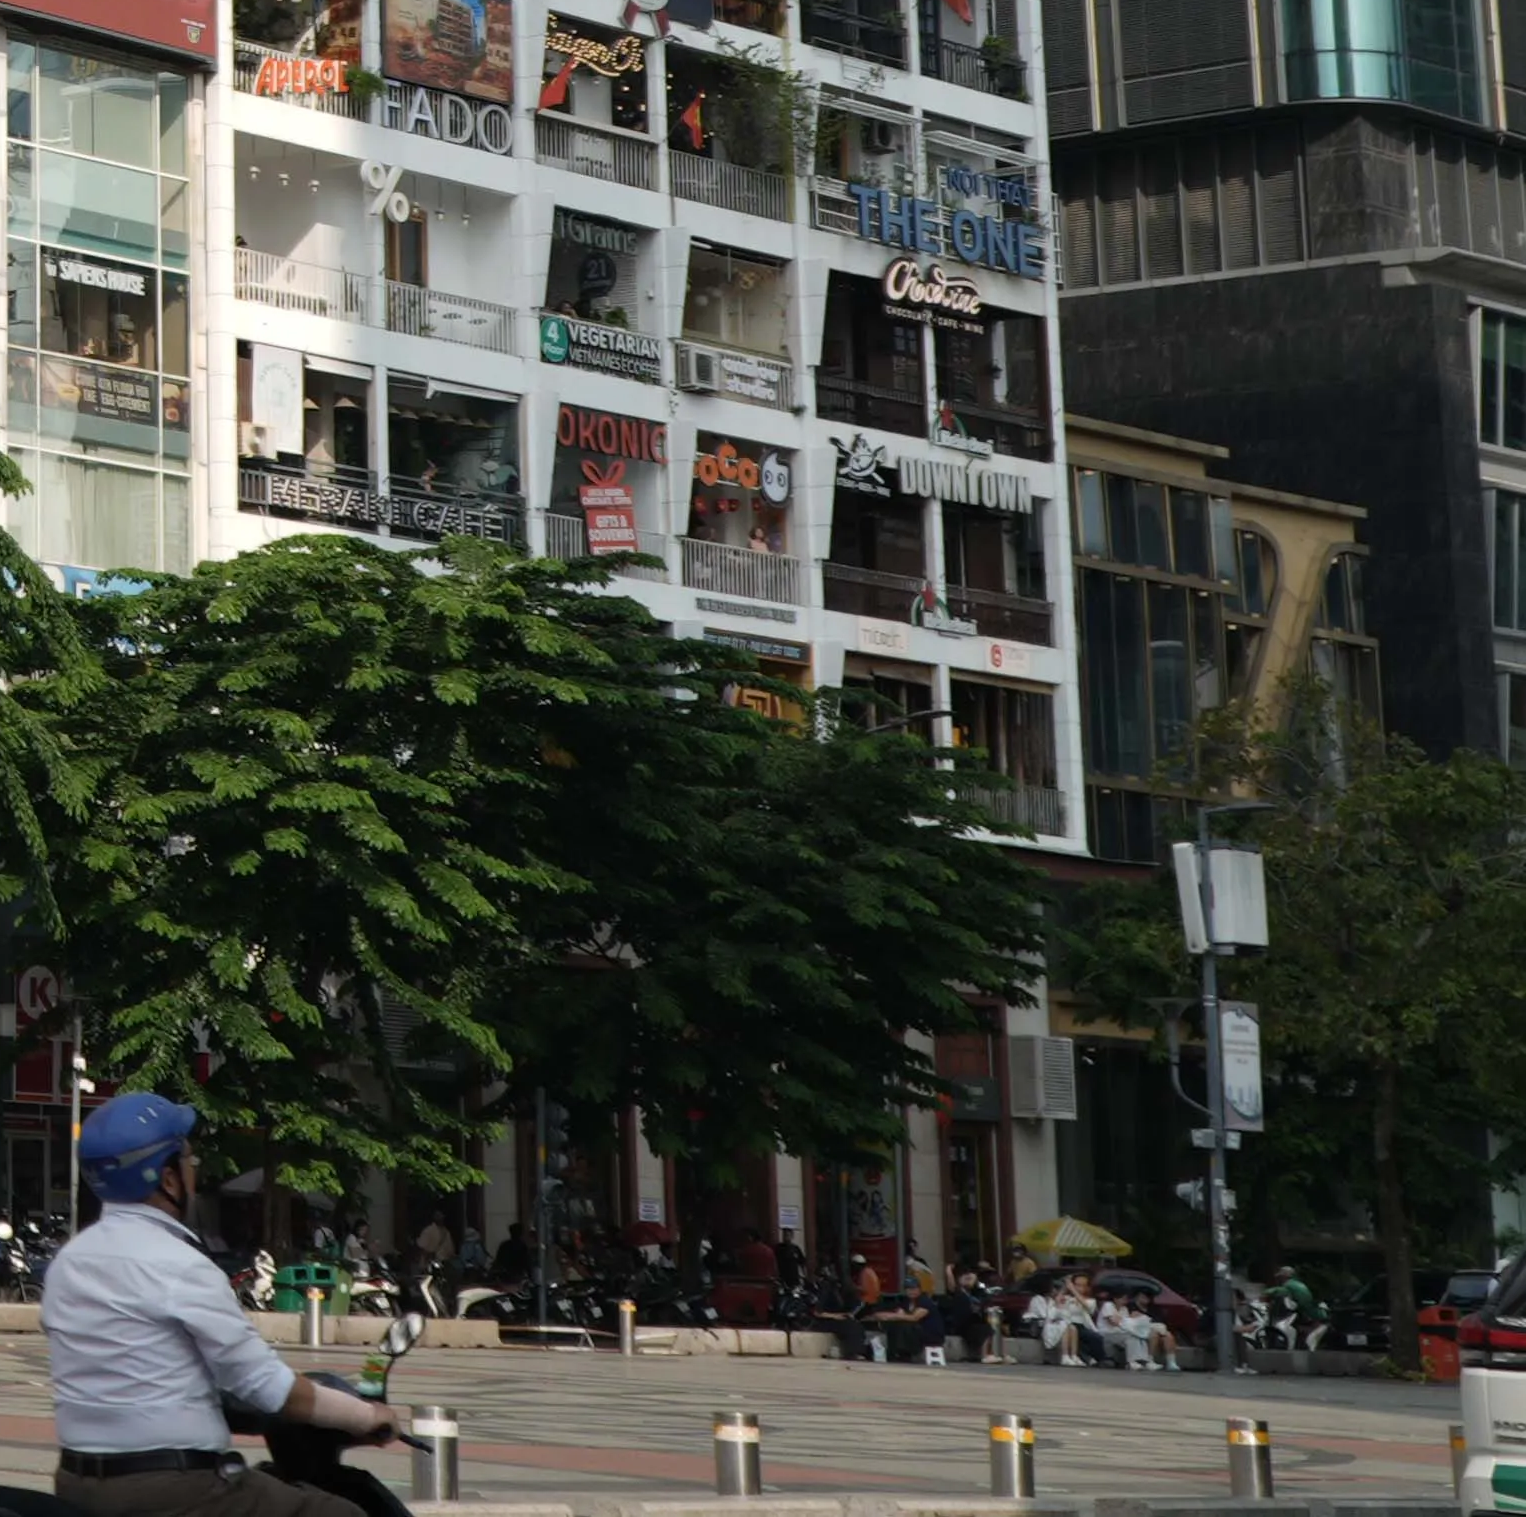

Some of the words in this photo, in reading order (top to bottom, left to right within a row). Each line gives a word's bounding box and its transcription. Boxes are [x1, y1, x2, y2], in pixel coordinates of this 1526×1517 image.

[382, 81, 514, 155] HADO
[849, 183, 941, 255] THE
[952, 209, 1047, 277] ONE
[547, 321, 560, 342] 4
[568, 322, 661, 360] VEGETARIAN
[899, 456, 1033, 514] DOWNTOWN
